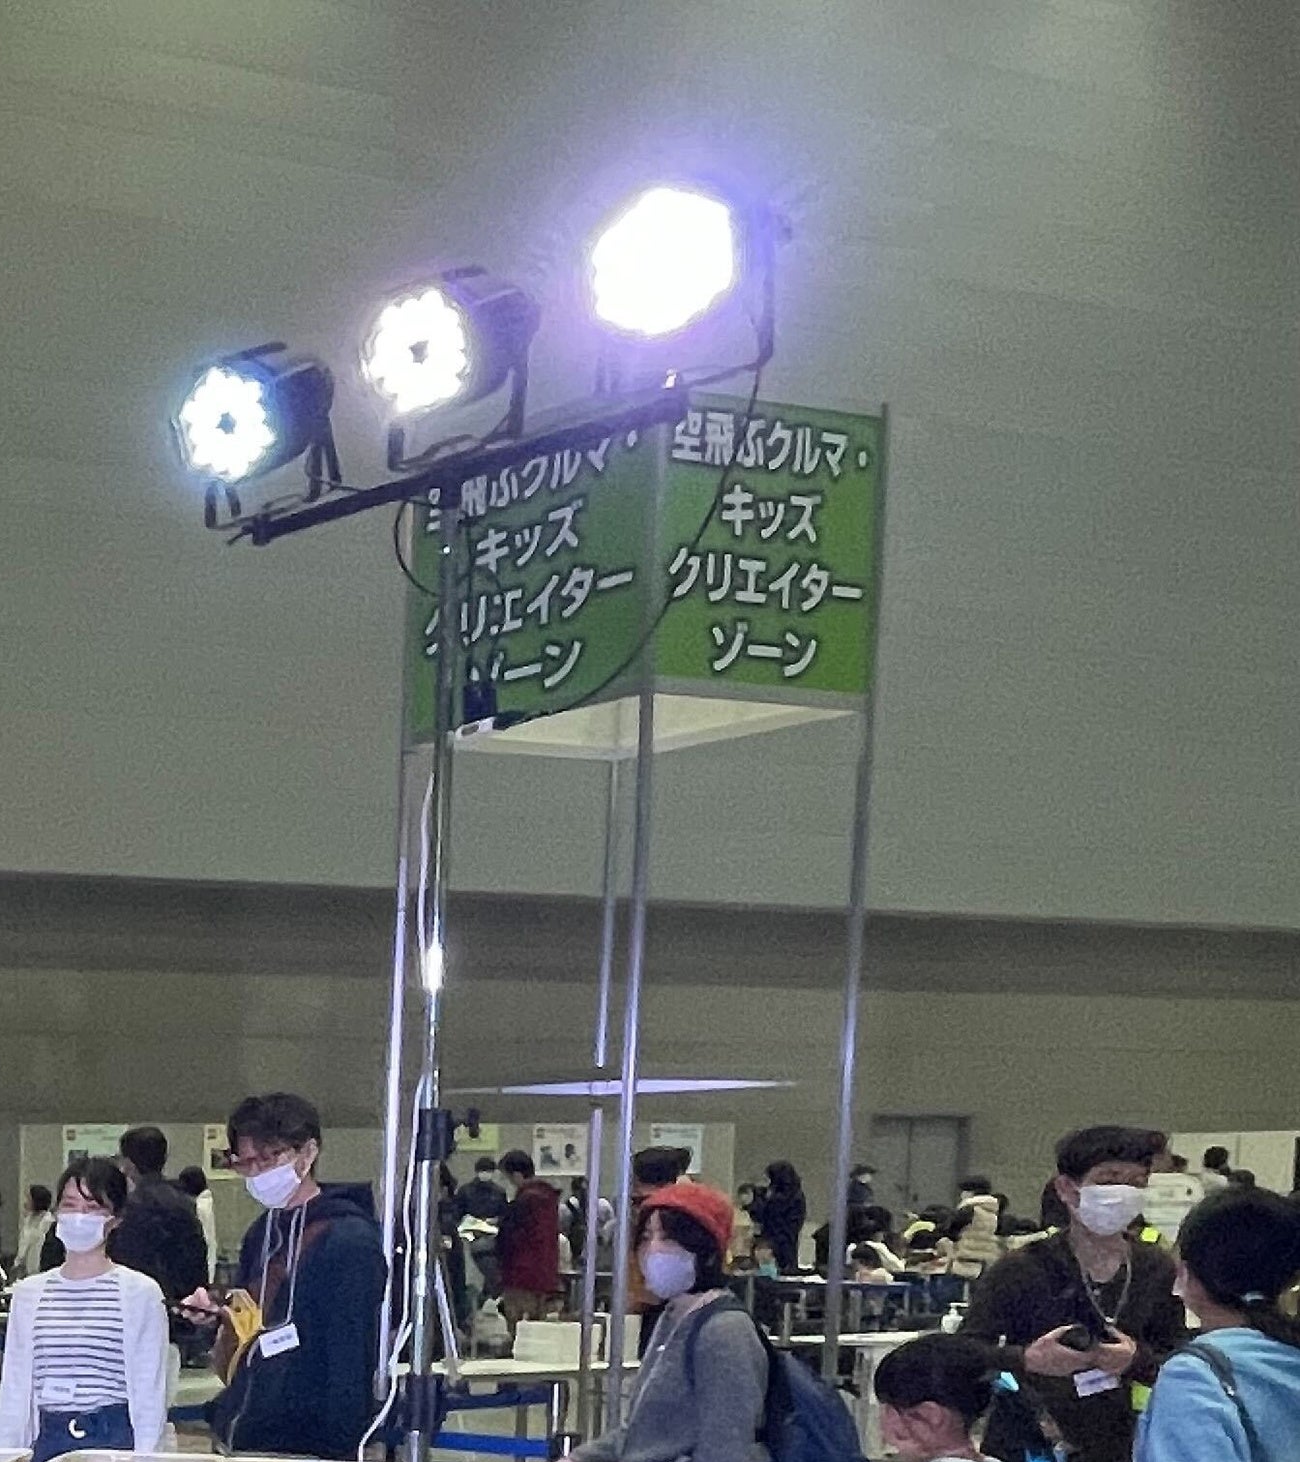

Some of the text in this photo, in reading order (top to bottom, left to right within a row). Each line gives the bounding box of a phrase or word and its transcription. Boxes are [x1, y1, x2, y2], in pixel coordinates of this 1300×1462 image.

[474, 499, 585, 572] キッズ
[720, 484, 822, 543] キッズ
[669, 547, 863, 611] クリエイター
[712, 621, 816, 677] ゾーン
